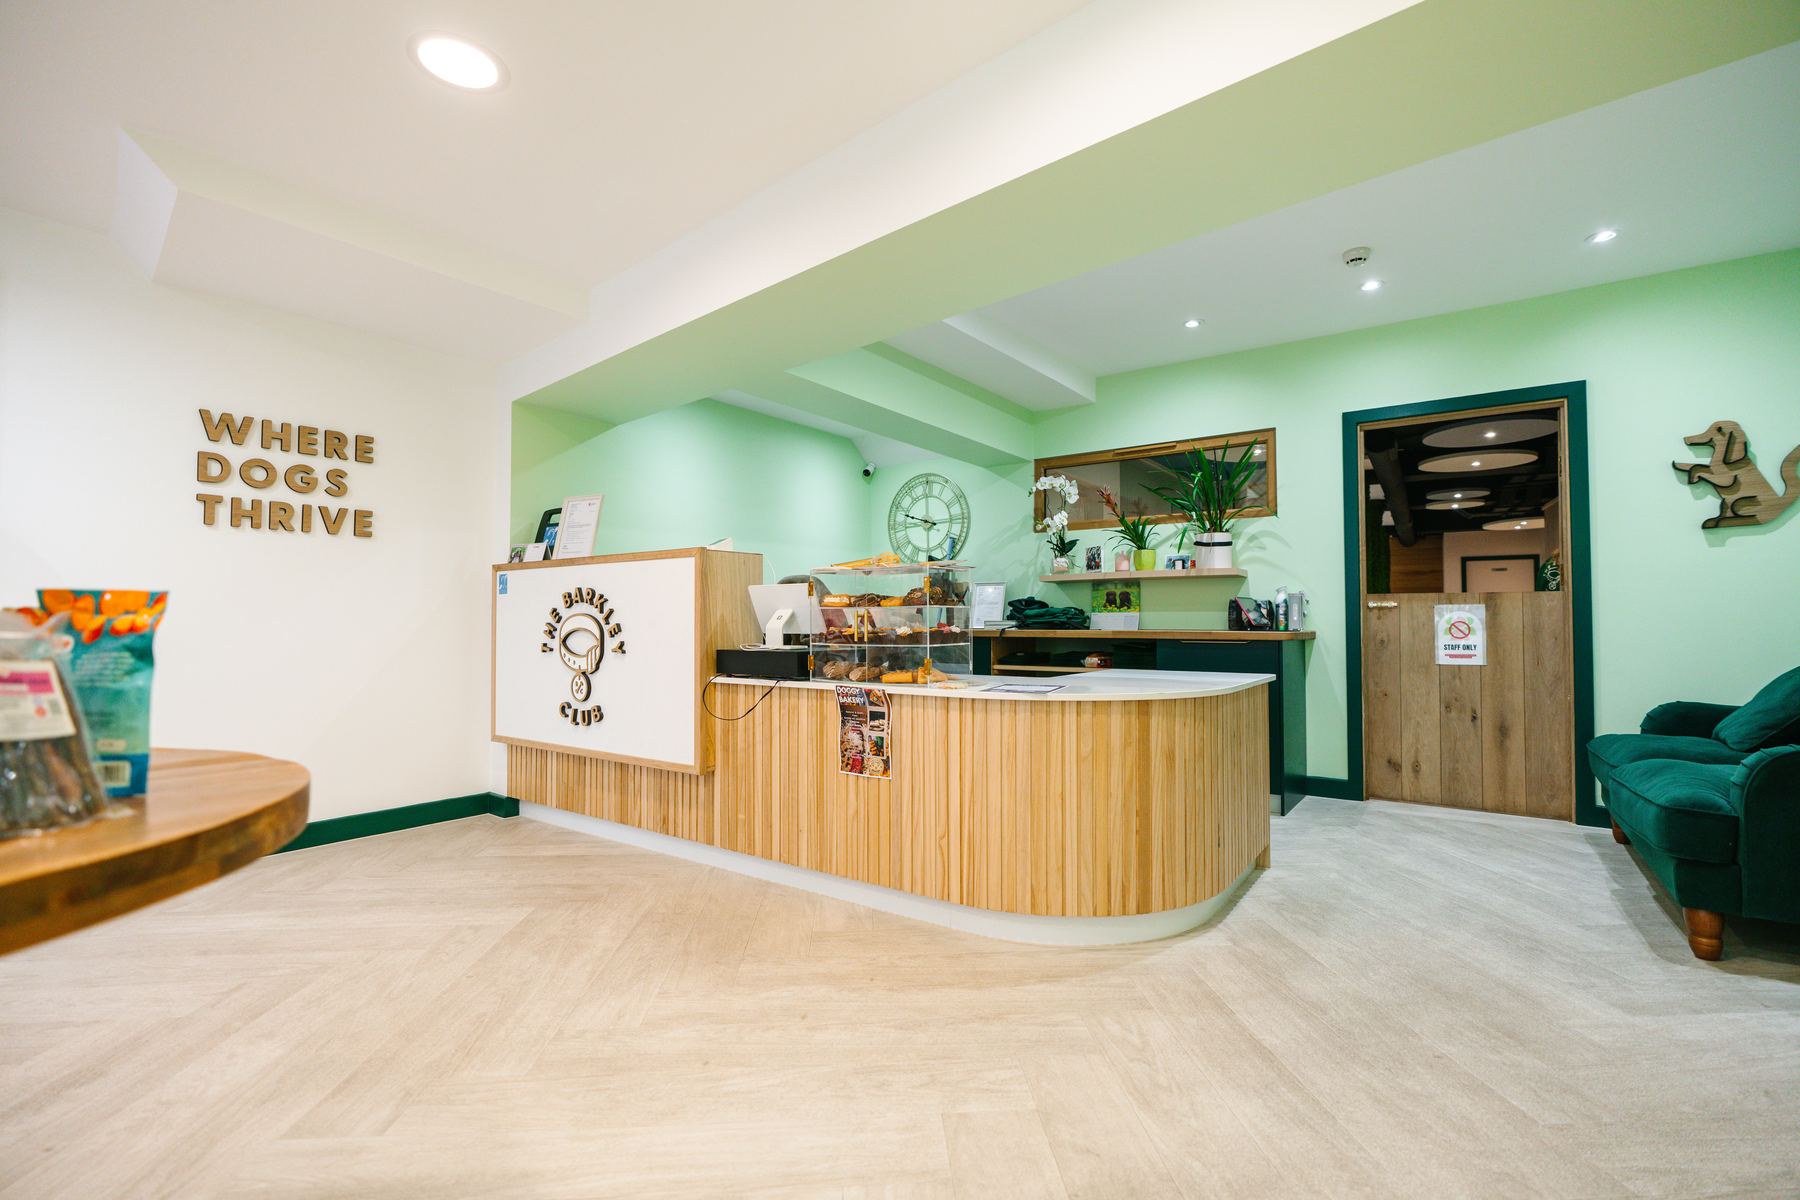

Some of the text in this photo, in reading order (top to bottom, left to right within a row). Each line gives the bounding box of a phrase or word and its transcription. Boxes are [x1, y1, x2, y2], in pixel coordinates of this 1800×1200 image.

[199, 409, 374, 463] WHERE
[197, 451, 348, 497] DOGS
[196, 493, 373, 537] THRIVE
[541, 587, 626, 654] THE BARKLEY
[836, 687, 860, 695] DOGGY
[839, 696, 864, 704] BAKERY
[559, 701, 604, 727] CLUB
